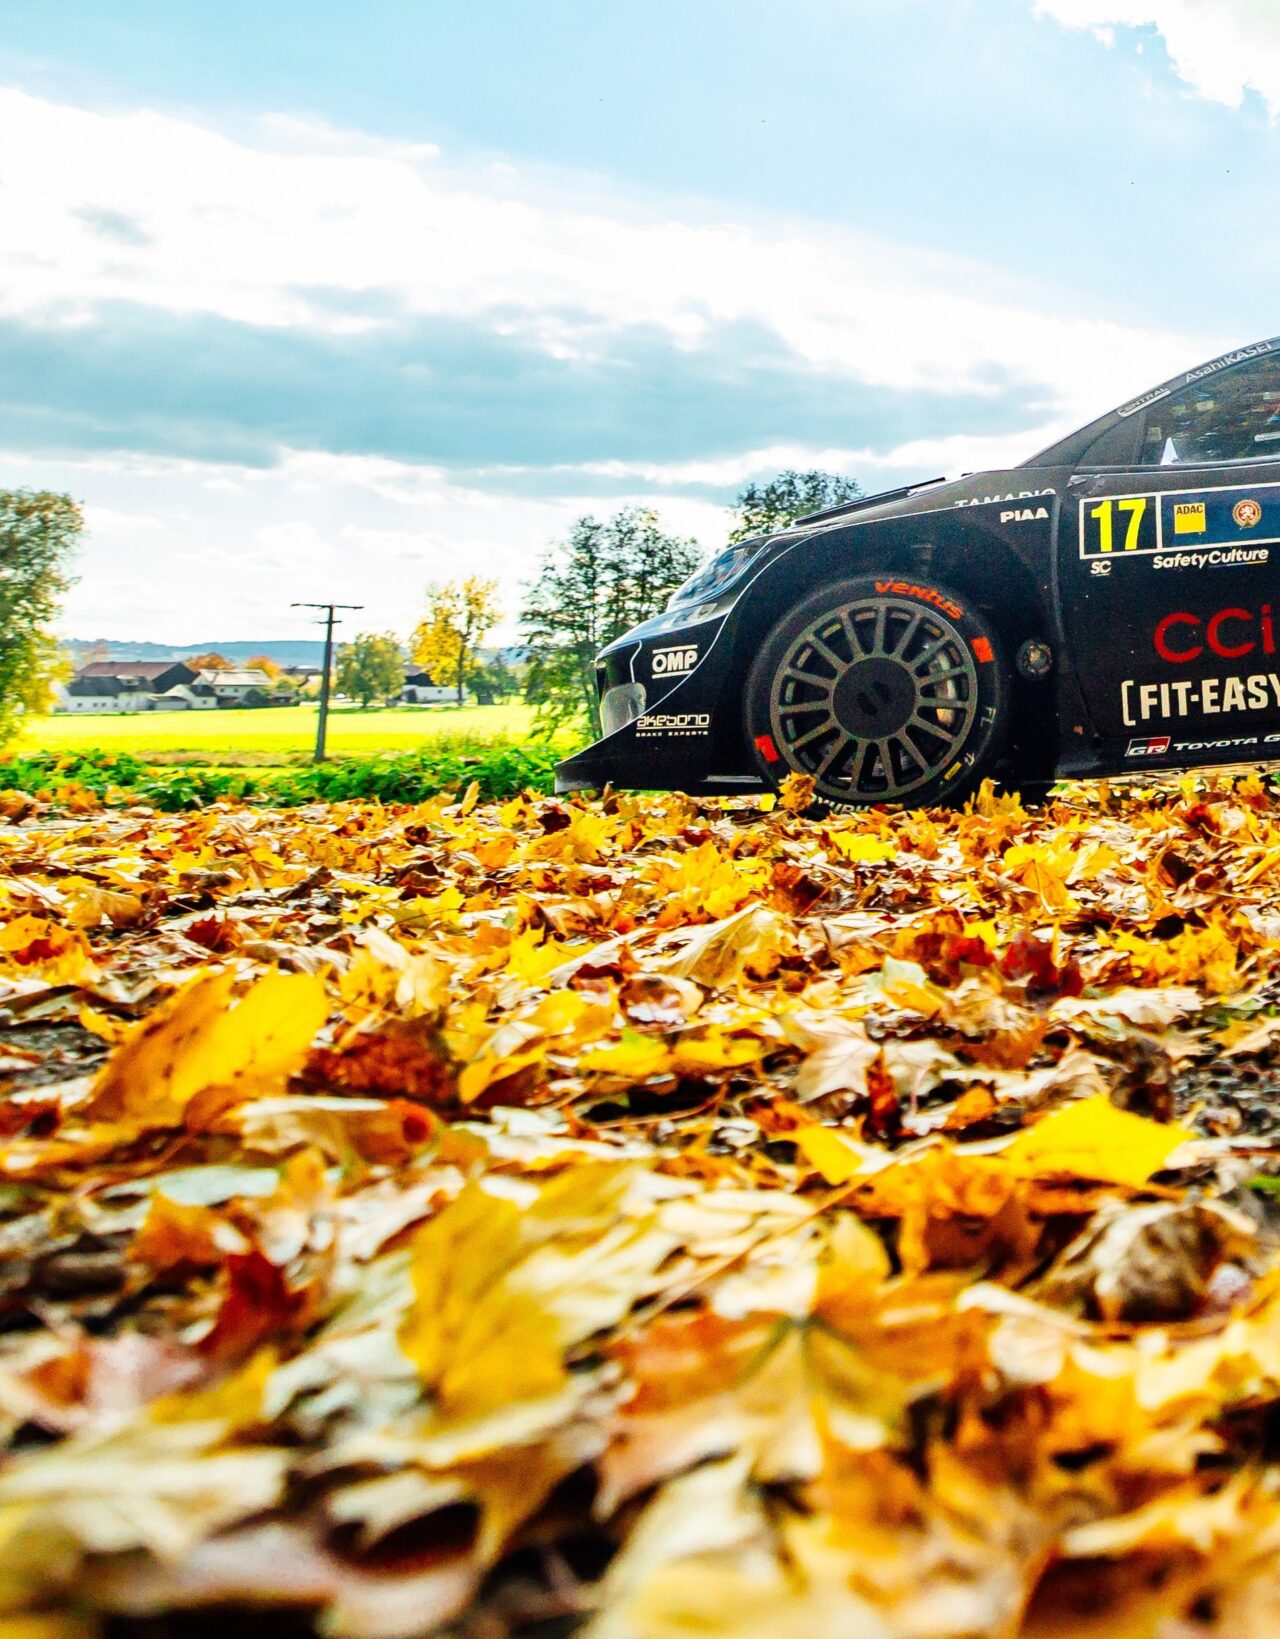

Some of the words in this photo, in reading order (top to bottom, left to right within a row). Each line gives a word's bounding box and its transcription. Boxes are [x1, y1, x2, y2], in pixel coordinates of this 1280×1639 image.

[1185, 342, 1273, 383] AsahiKASEI
[1000, 507, 1049, 523] PIAA
[1176, 505, 1204, 516] ADAC
[1091, 498, 1147, 553] 17
[1090, 560, 1112, 575] SC
[1153, 548, 1269, 570] SafetyCulture
[652, 650, 698, 673] OMP
[636, 714, 709, 727] akebono
[1127, 743, 1166, 755] GR
[1173, 737, 1258, 751] TOYOTA
